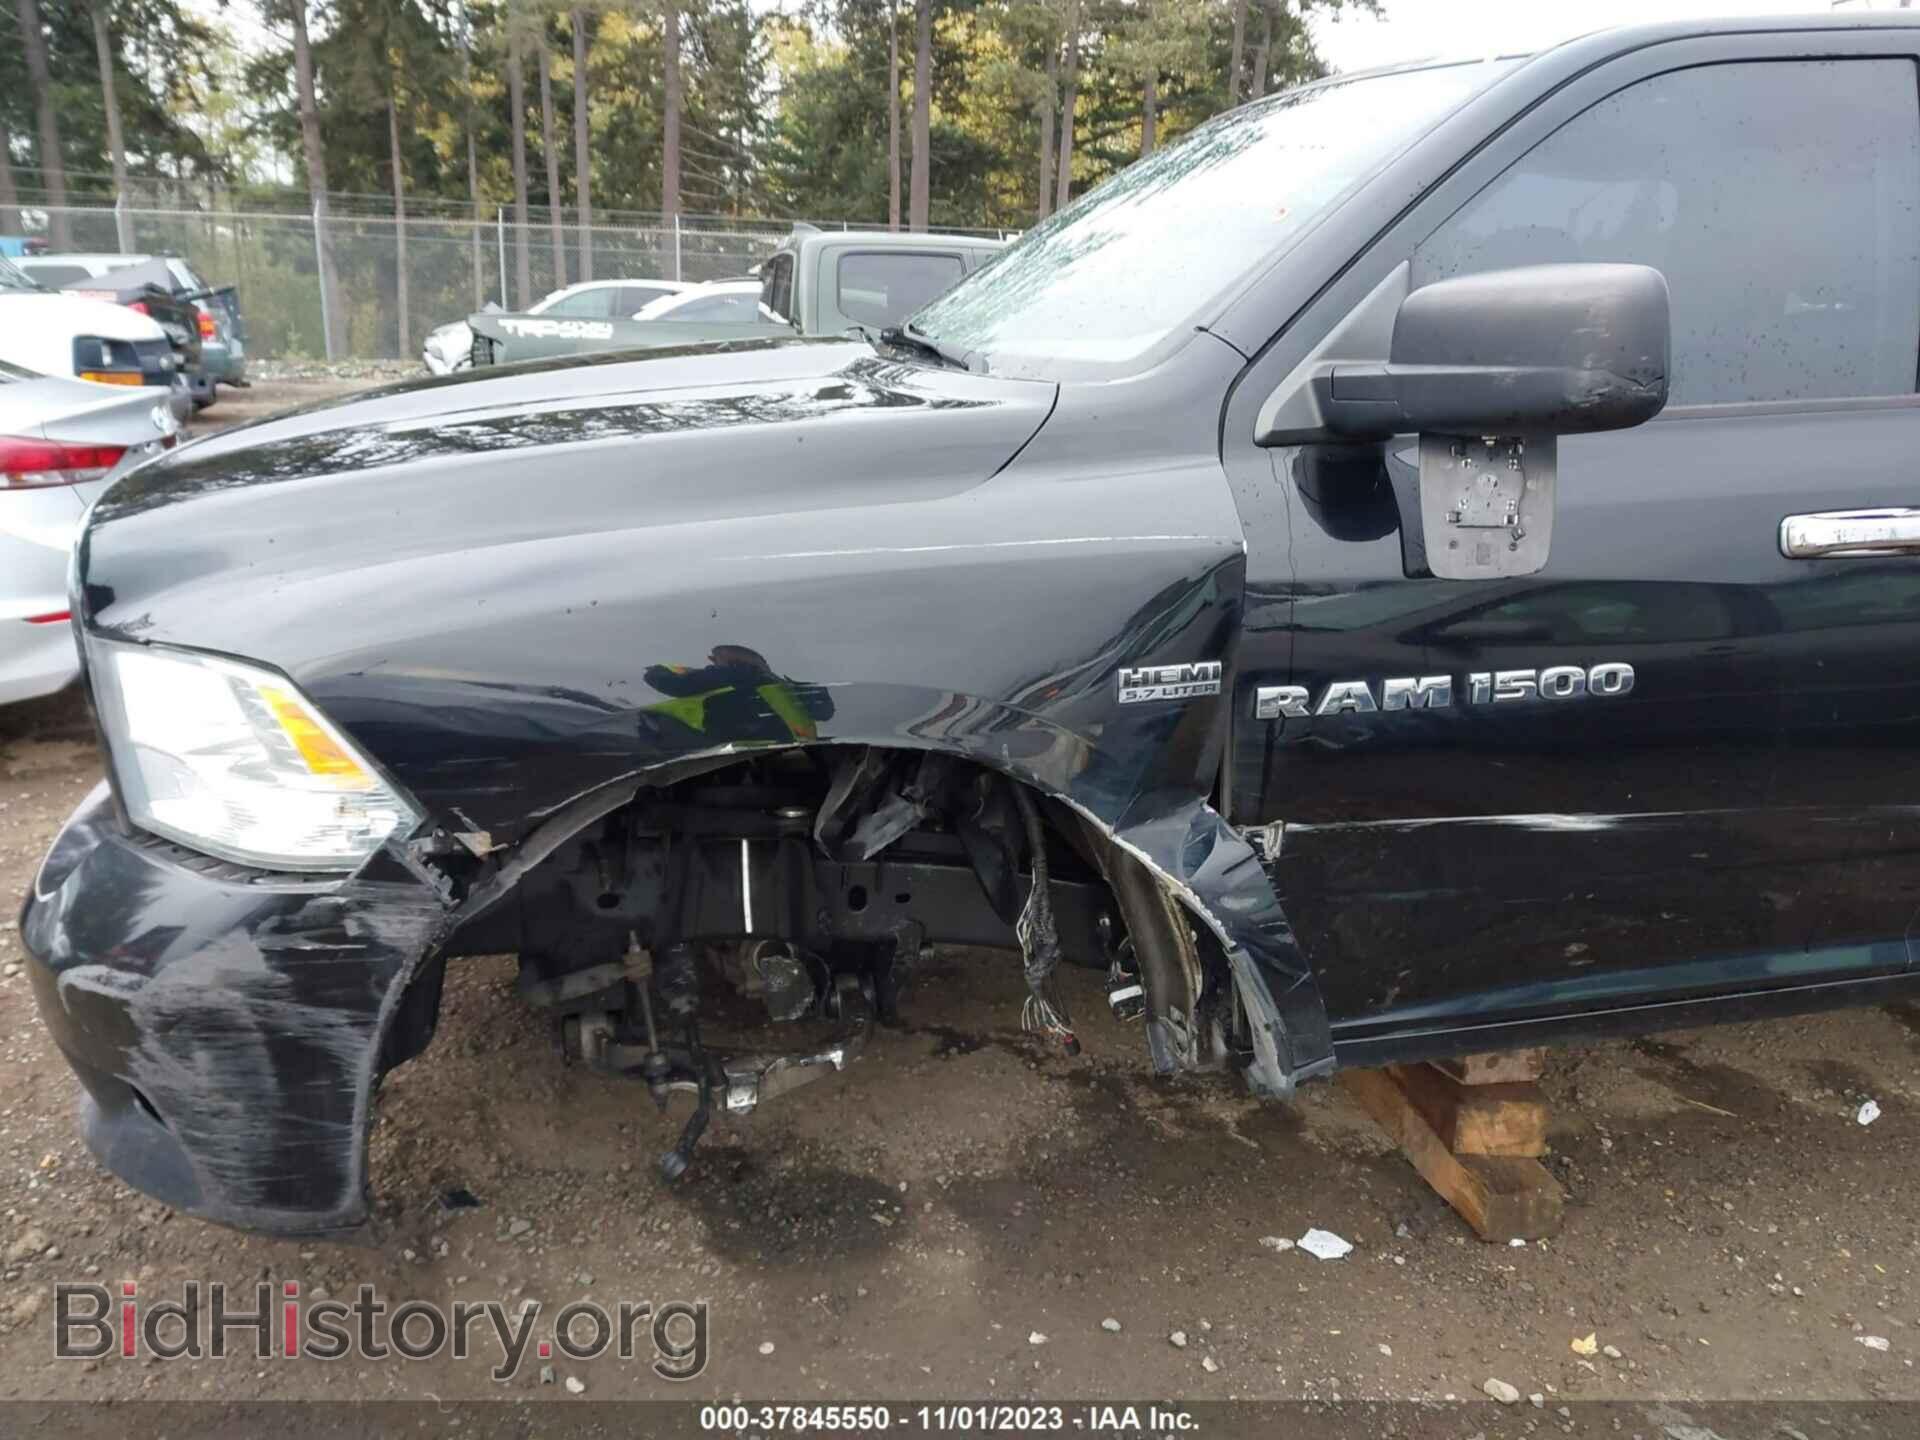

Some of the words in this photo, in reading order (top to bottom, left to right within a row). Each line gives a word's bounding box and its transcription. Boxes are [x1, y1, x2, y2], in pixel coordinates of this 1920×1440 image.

[1118, 661, 1222, 689] HEMI
[1125, 689, 1156, 701] 5.7
[1162, 682, 1217, 697] LITER
[1255, 675, 1452, 719] RAM
[1469, 662, 1635, 704] 1500
